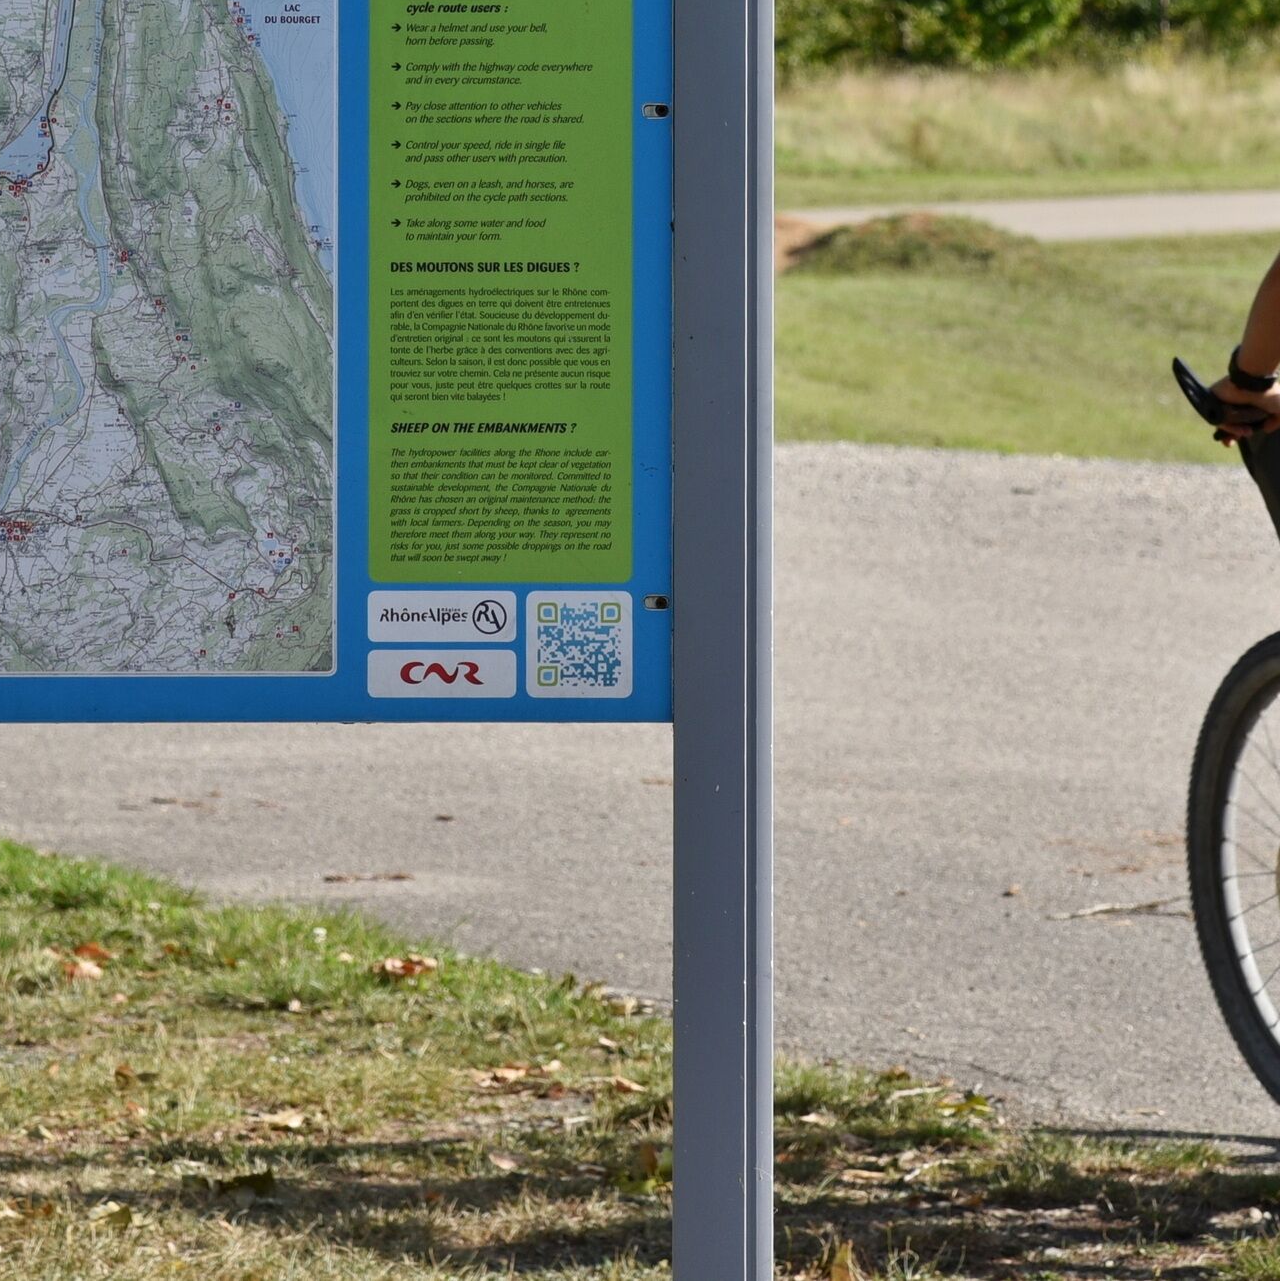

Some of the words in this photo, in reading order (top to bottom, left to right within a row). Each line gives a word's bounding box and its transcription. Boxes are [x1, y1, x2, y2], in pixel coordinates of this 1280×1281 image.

[284, 4, 301, 12] LAC
[406, 3, 435, 16] cycle
[437, 4, 468, 13] route
[470, 5, 502, 13] users
[504, 5, 509, 13] :
[264, 15, 277, 24] DU
[280, 15, 320, 24] BOURGET
[405, 23, 430, 32] Wear
[437, 23, 469, 32] helmet
[470, 23, 488, 32] and
[506, 25, 529, 35] your
[529, 23, 548, 33] bell,
[405, 36, 428, 45] horn
[428, 36, 459, 45] before
[459, 37, 495, 48] passing.
[405, 62, 441, 74] Comply
[441, 62, 461, 71] with
[462, 62, 478, 71] the
[478, 62, 516, 74] highway
[516, 62, 540, 71] code
[540, 62, 594, 74] everywhere
[405, 75, 423, 84] and
[423, 76, 435, 84] in
[434, 77, 461, 87] every
[461, 76, 521, 84] circumstance.
[391, 261, 413, 273] DES
[416, 261, 474, 273] MOUTONS
[478, 261, 500, 273] SUR
[504, 261, 523, 273] LES
[527, 261, 570, 273] DIGUES
[574, 261, 579, 273] ?
[390, 393, 403, 403] qui
[404, 393, 430, 401] seront
[431, 392, 449, 401] bien
[450, 393, 465, 401] vite
[466, 392, 501, 403] balayées
[390, 423, 429, 434] SHEEP
[431, 423, 450, 434] ON
[452, 423, 475, 434] THE
[477, 423, 567, 434] EMBANKMENTS
[569, 423, 577, 434] ?
[400, 661, 485, 685] CNR
